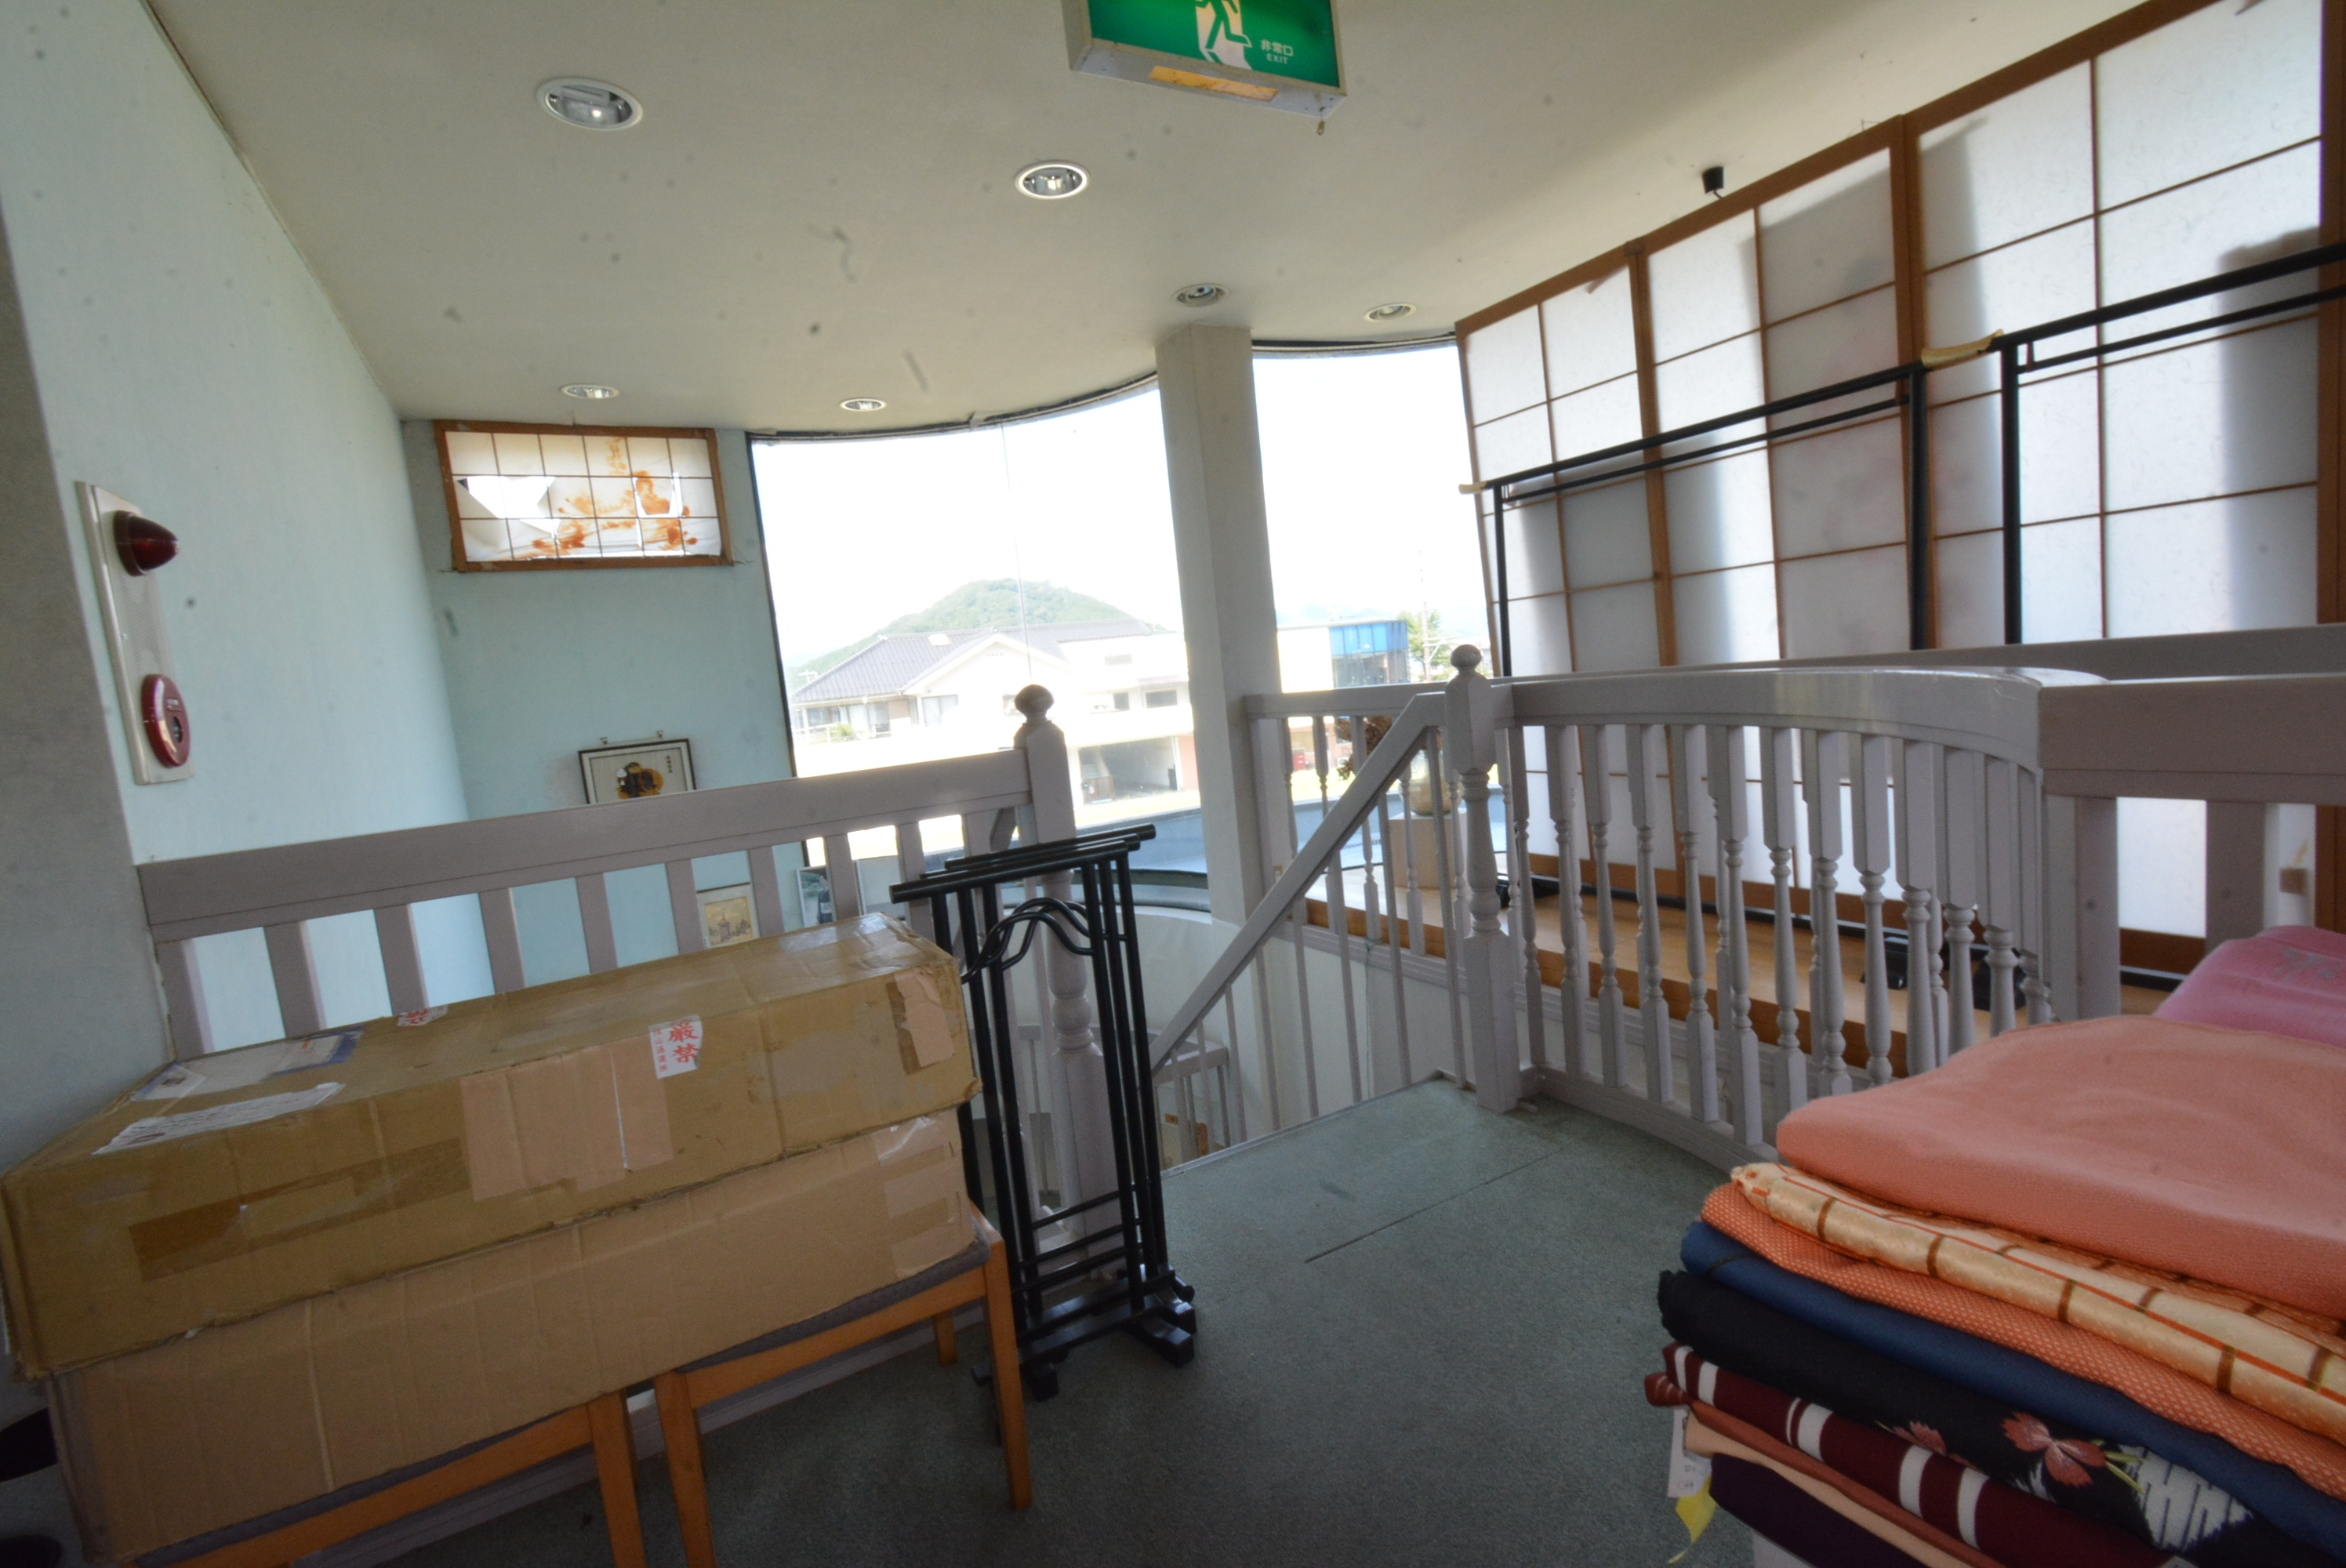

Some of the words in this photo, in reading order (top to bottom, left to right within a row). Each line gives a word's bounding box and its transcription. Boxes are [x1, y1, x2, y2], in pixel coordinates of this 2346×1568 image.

[1261, 38, 1294, 56] 非常口
[1266, 53, 1288, 64] EXIT
